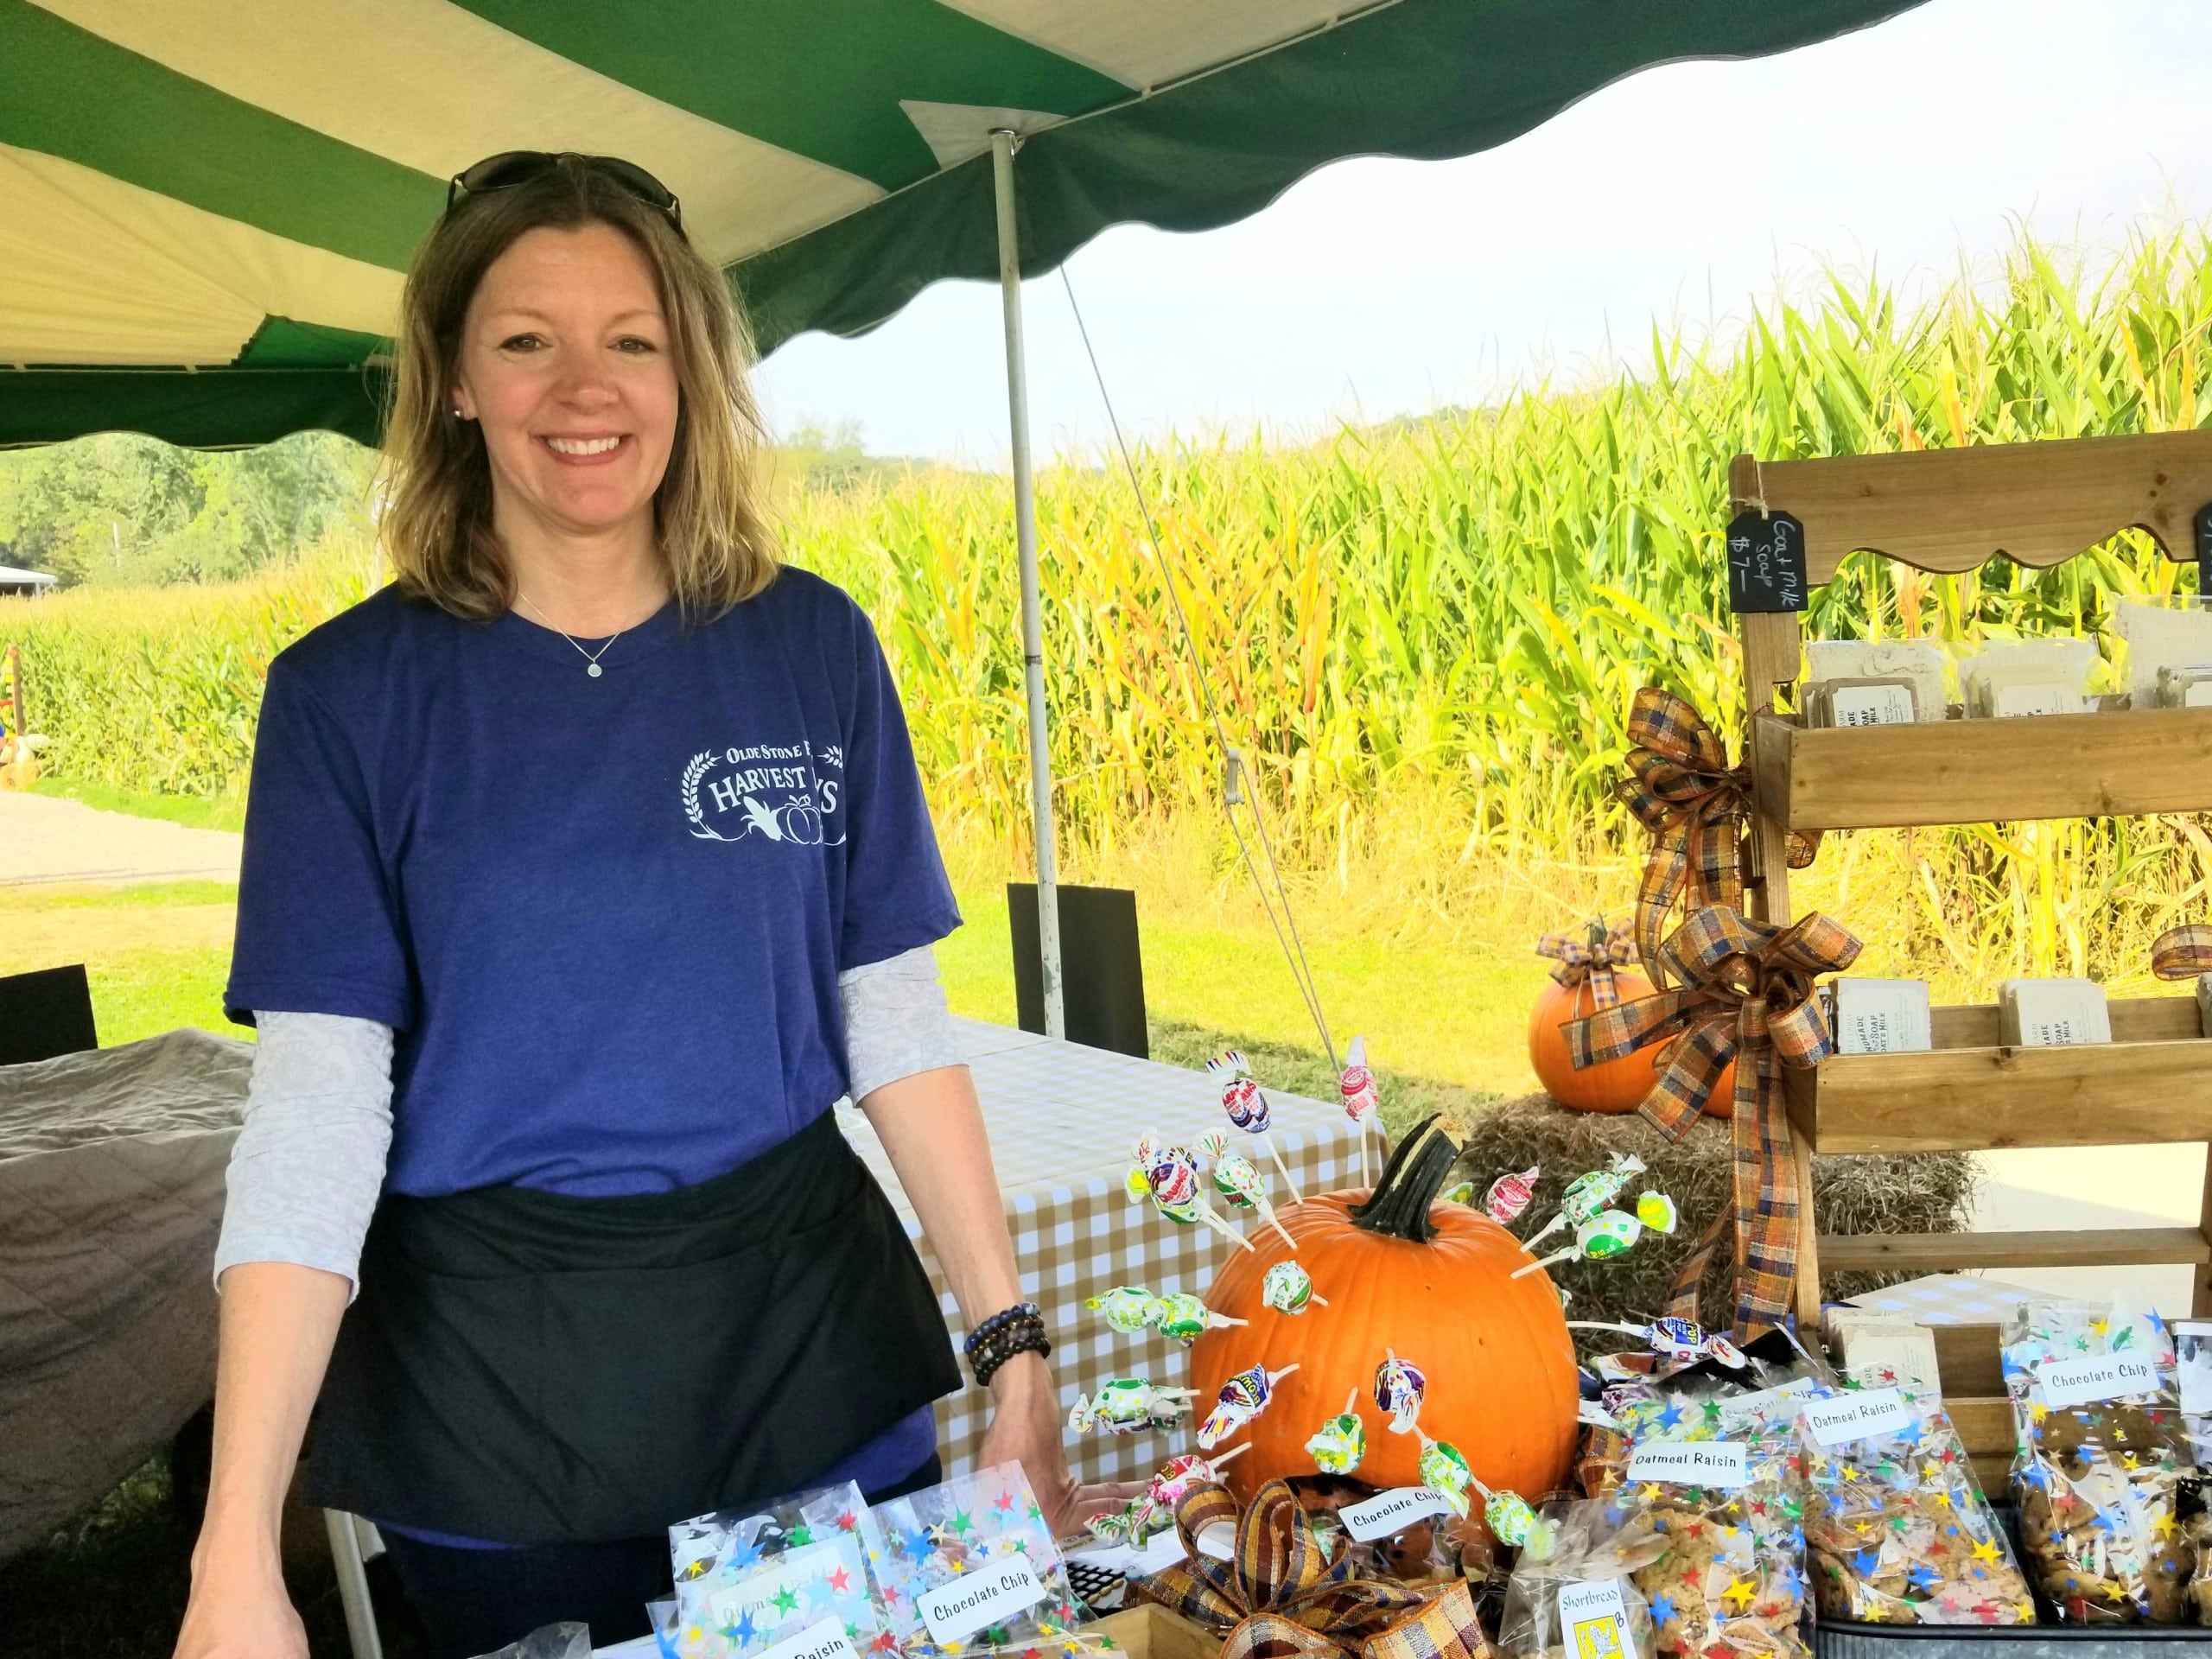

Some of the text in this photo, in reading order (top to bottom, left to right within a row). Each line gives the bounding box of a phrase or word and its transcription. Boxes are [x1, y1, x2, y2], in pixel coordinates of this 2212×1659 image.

[1773, 520, 1796, 565] Goat
[709, 766, 806, 812] HARVEST
[1857, 1015, 1872, 1052] NDMADE
[1870, 1015, 1879, 1039] SOAP
[2052, 1364, 2147, 1387] Chocolate Chip
[1813, 1402, 1897, 1428] Oatmeal Raisin
[1636, 1452, 1736, 1467] Oatmeal Raisin
[1353, 1499, 1413, 1526] Chocolate
[934, 1573, 1029, 1621] Chocolate Chip
[1562, 1590, 1618, 1610] Shortbread
